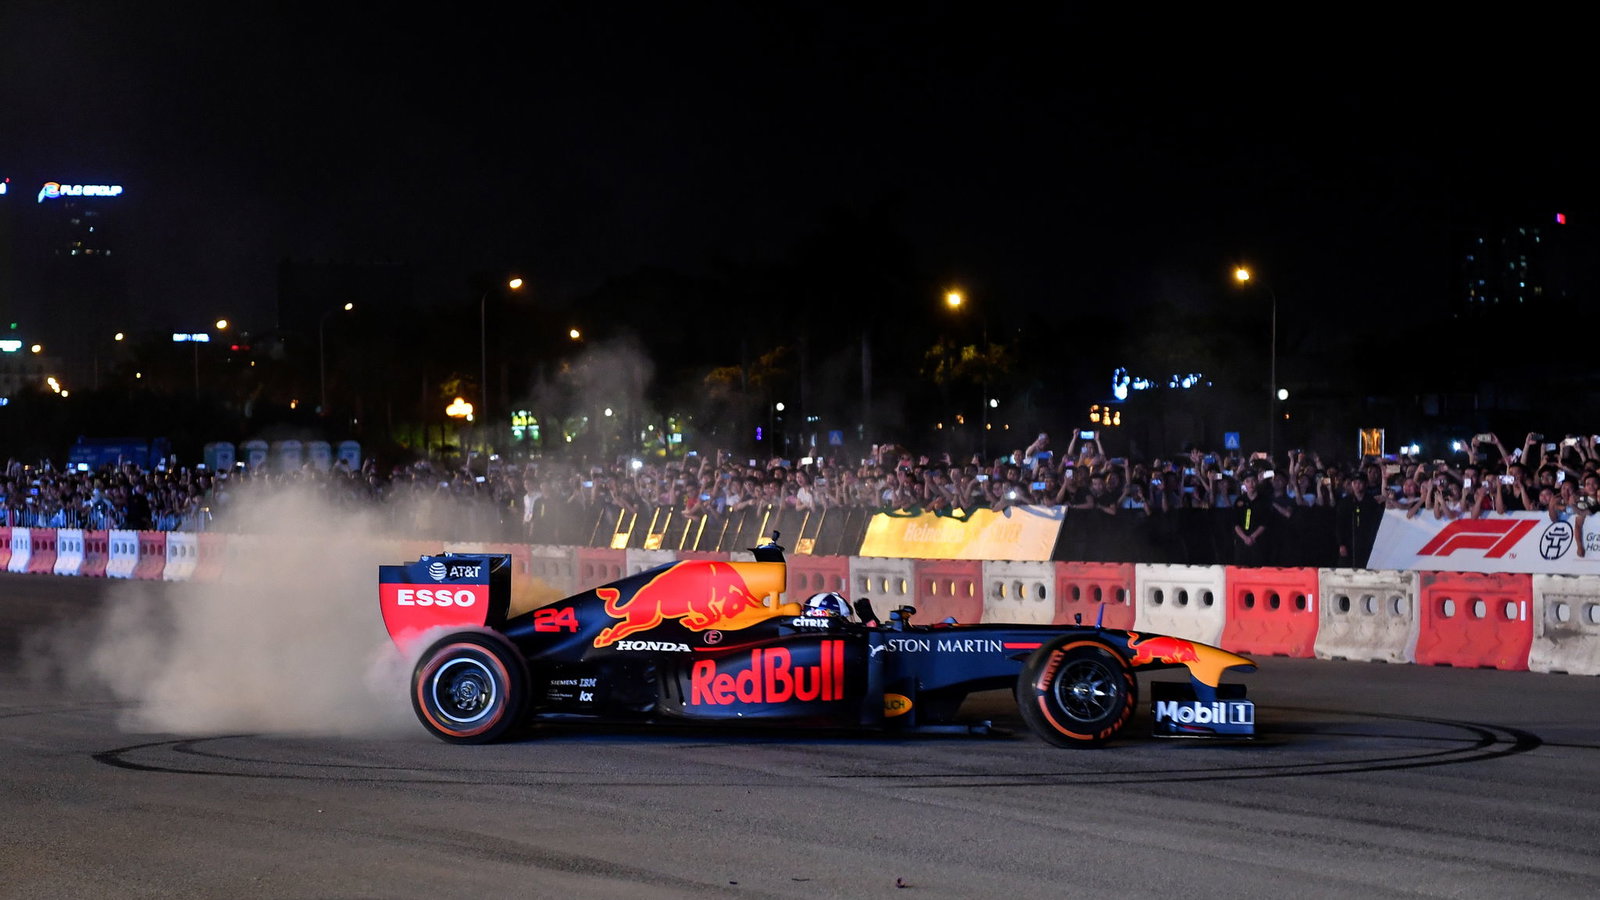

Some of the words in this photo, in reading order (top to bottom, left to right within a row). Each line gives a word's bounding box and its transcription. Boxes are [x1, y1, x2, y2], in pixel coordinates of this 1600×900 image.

[82, 185, 122, 196] GROUP
[449, 566, 481, 578] AT&T
[397, 589, 476, 607] ESSO
[533, 606, 579, 633] 24
[616, 640, 692, 653] HONDA
[937, 639, 1002, 652] MARTIN
[579, 678, 597, 687] IBM
[1156, 700, 1227, 724] Mobil
